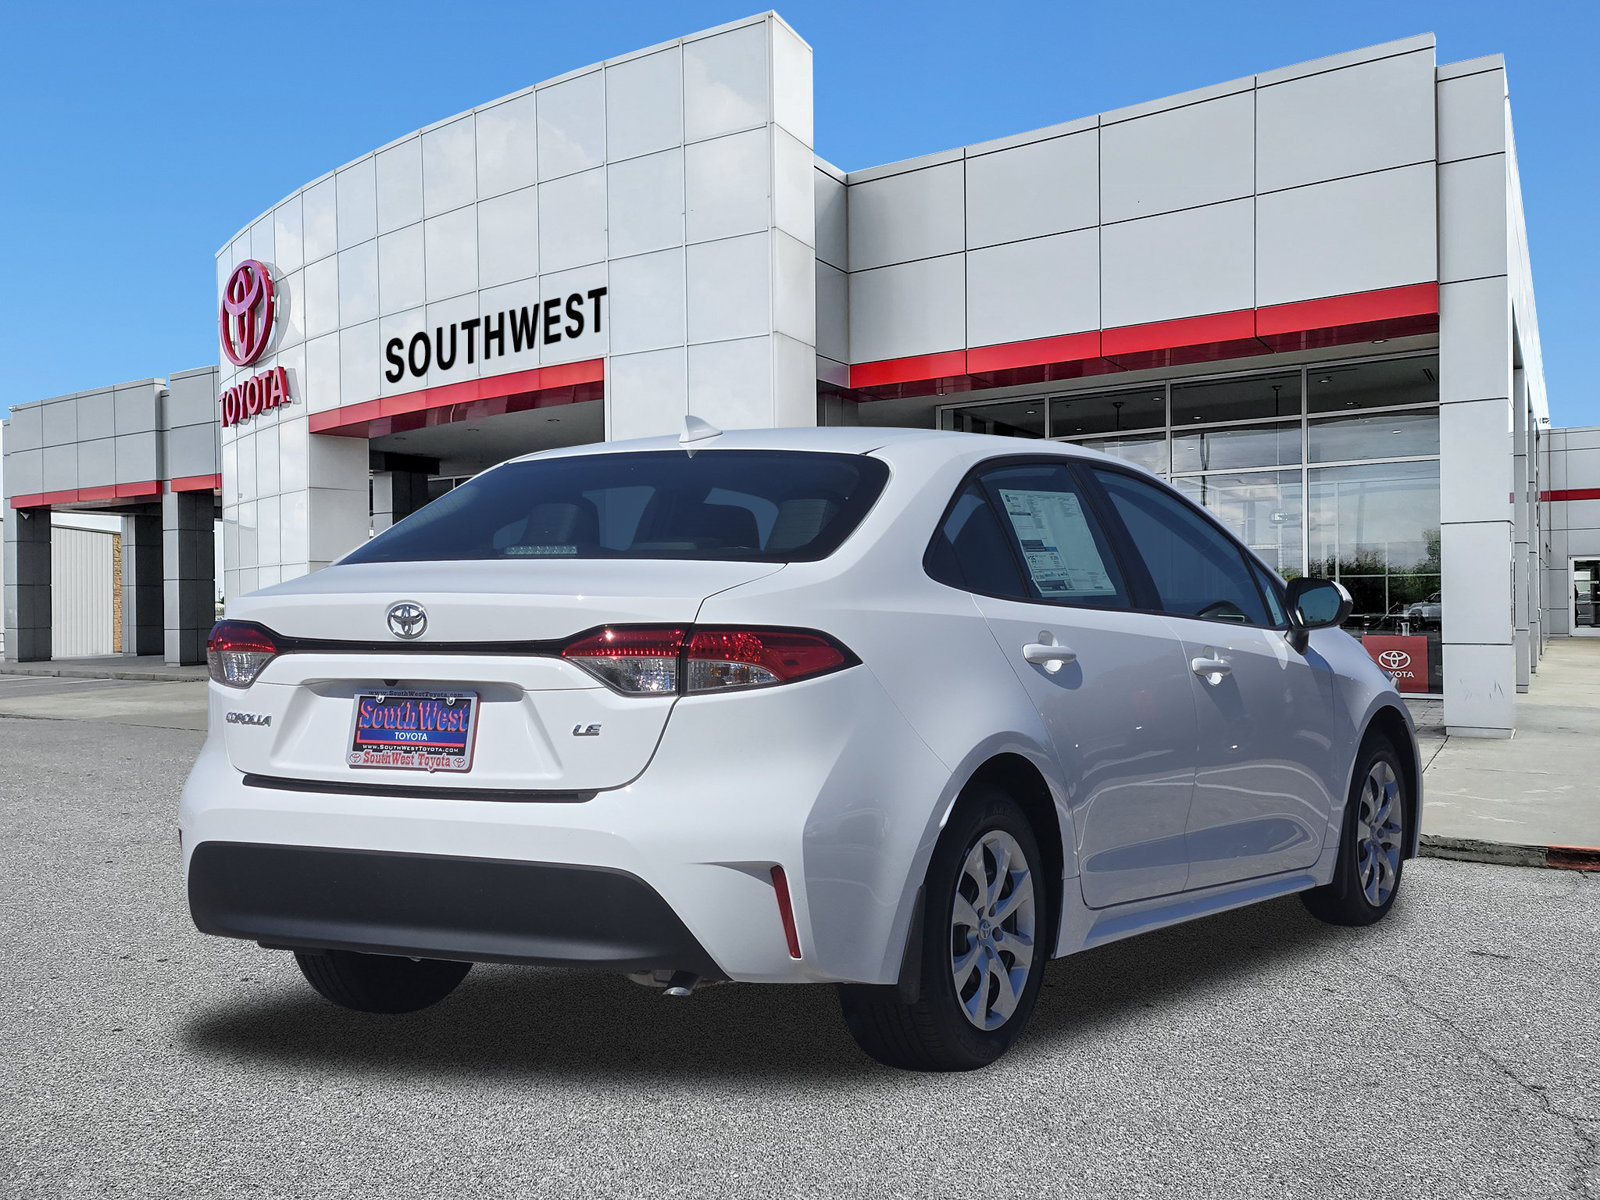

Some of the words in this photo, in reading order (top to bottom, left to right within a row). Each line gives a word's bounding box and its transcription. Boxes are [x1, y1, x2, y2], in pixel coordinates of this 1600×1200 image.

[386, 287, 607, 384] SOUTHWEST
[219, 366, 291, 427] TOYOTA
[226, 712, 272, 727] COROLLA
[395, 732, 427, 741] TOYOTA
[573, 725, 601, 736] LE
[363, 752, 414, 765] SouthWest
[418, 753, 450, 769] Toyota
